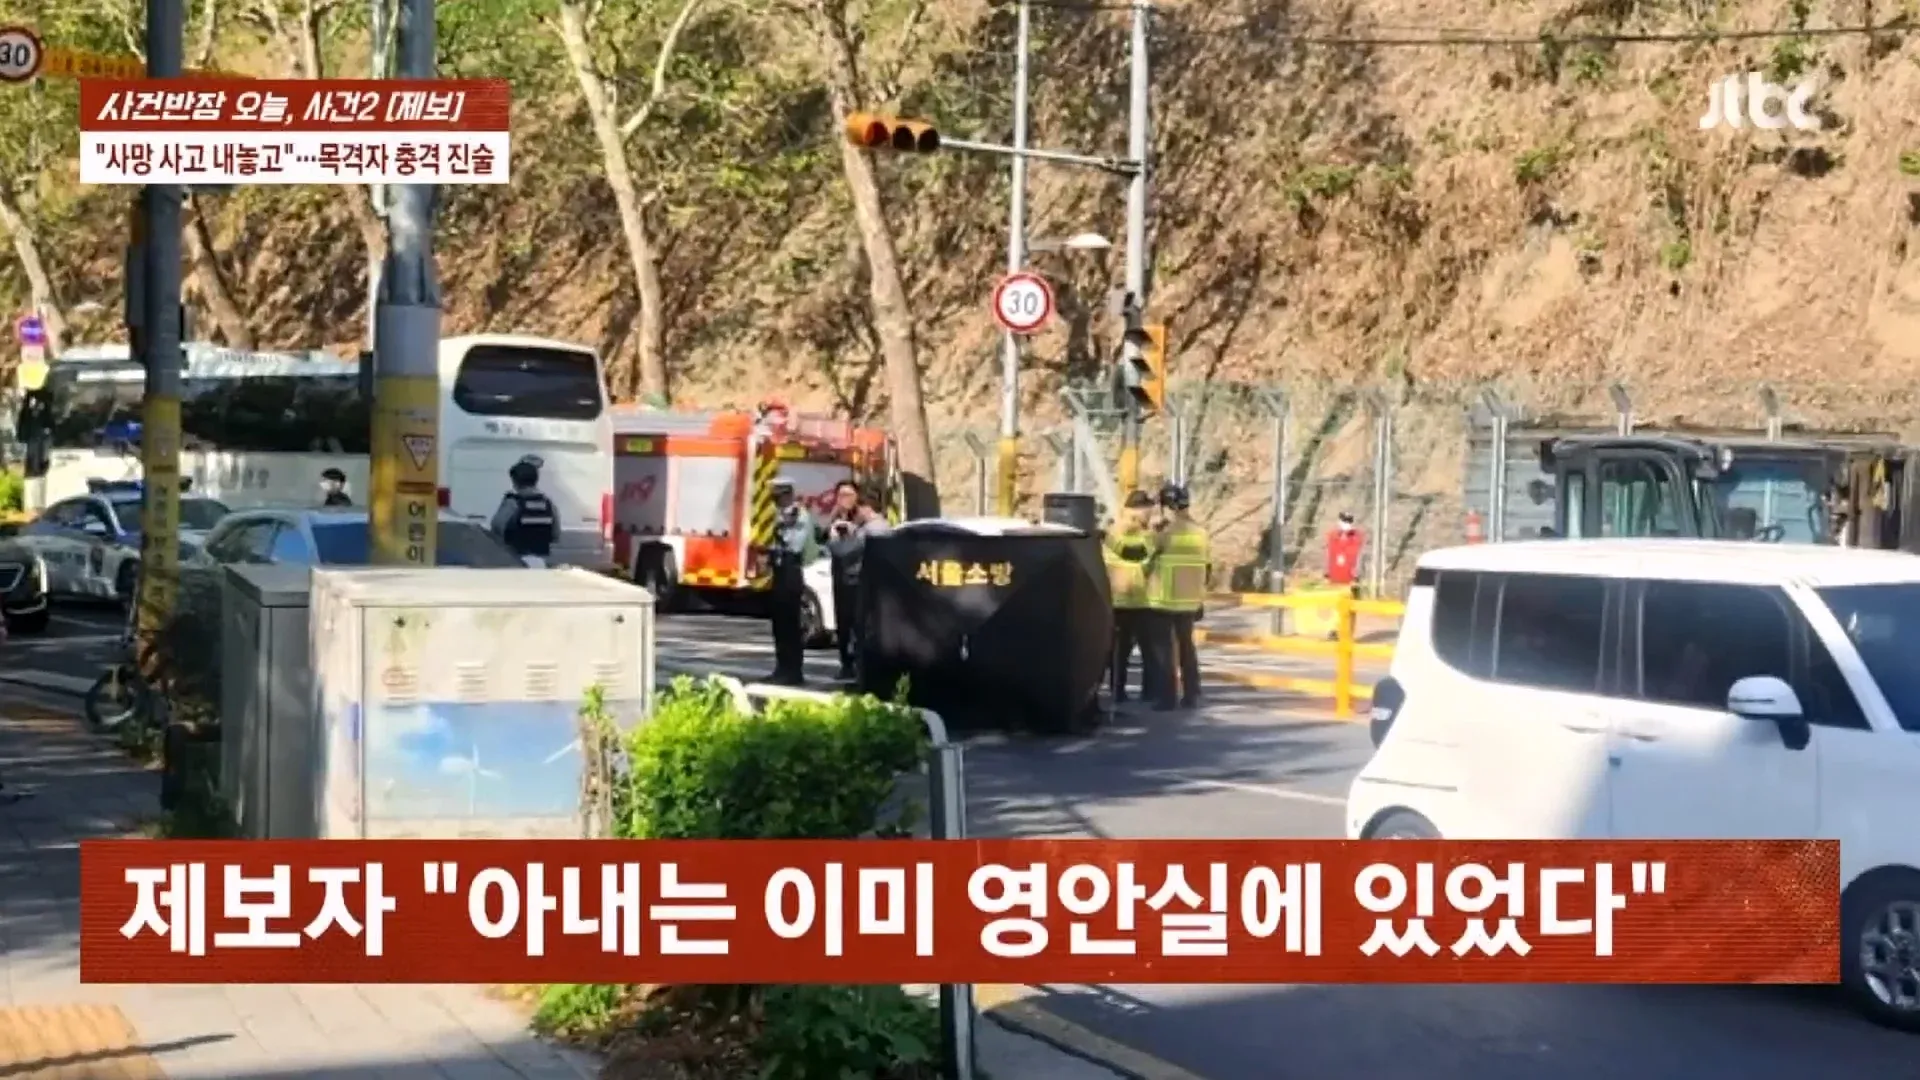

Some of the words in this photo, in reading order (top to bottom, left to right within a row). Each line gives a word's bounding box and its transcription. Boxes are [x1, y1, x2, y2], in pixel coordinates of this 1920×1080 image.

[0, 42, 30, 67] 30
[1007, 290, 1038, 316] 30
[916, 560, 1013, 586] 서울소방
